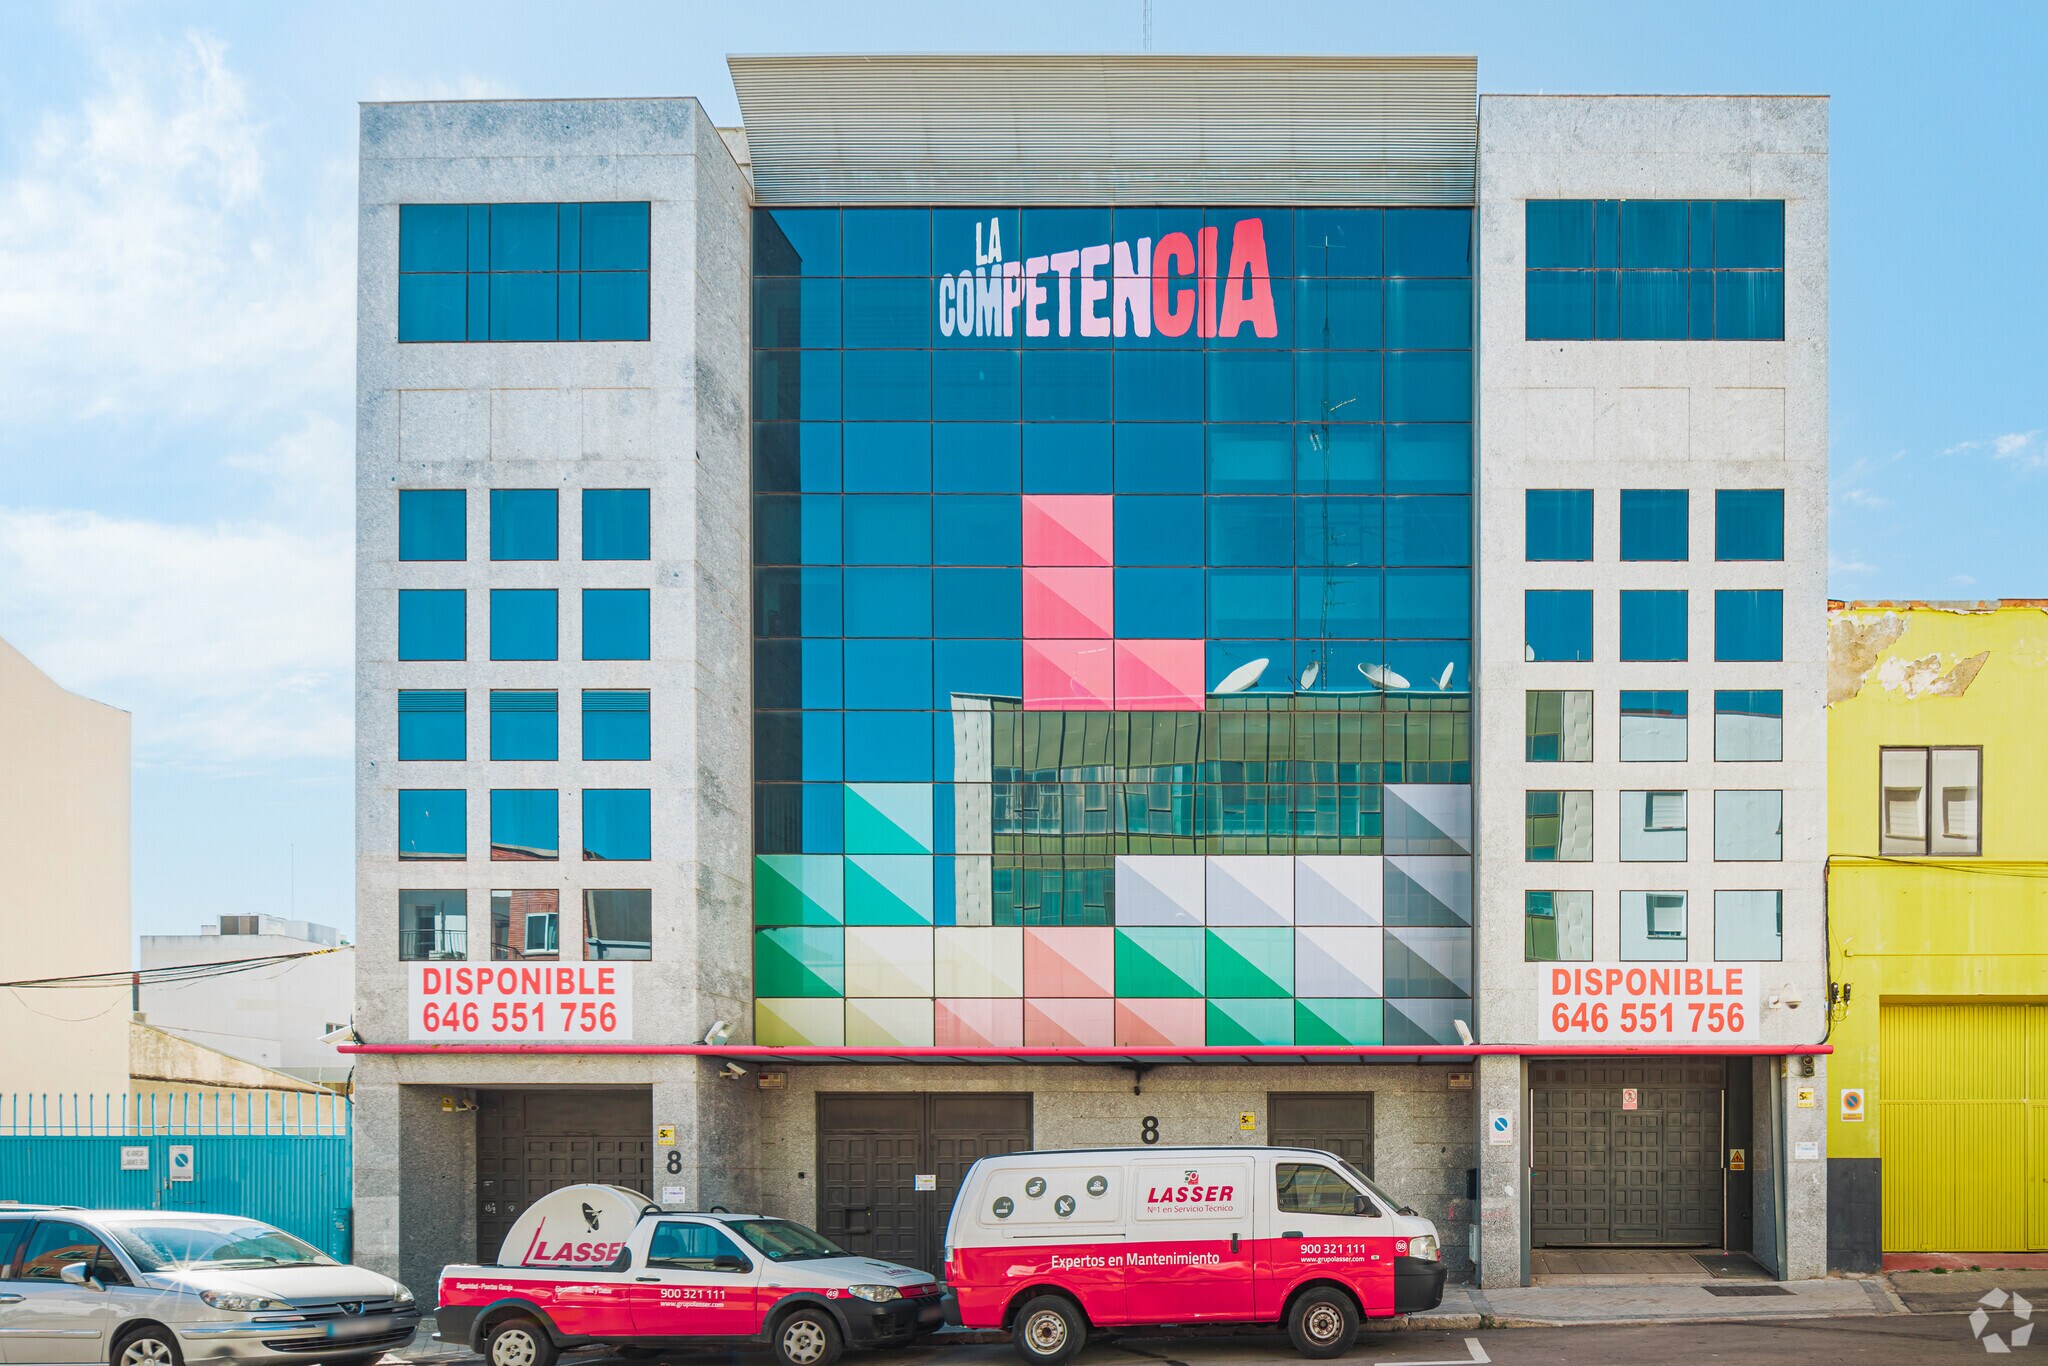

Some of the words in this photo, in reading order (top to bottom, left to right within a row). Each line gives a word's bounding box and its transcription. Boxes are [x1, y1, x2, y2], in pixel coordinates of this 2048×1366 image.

[975, 216, 1003, 267] LA
[938, 217, 1279, 339] COMPETENCIA
[422, 967, 616, 996] DISPONIBLE
[1551, 968, 1744, 996] DISPONIBLE
[422, 1001, 480, 1034] 646
[491, 1001, 545, 1034] 551
[560, 1001, 618, 1034] 756
[1551, 1002, 1609, 1034] 646
[1620, 1002, 1674, 1034] 551
[1687, 1002, 1745, 1034] 756
[1140, 1115, 1160, 1145] 8
[666, 1150, 682, 1175] 8
[1147, 1185, 1234, 1204] LASSER
[1174, 1205, 1203, 1213] Servicio
[1205, 1204, 1234, 1213] Técnico
[533, 1241, 627, 1263] LASSE
[1300, 1243, 1321, 1255] 900
[1323, 1243, 1343, 1254] 321
[1346, 1243, 1365, 1254] 111
[1300, 1255, 1365, 1265] www.grupolasser.com
[1051, 1255, 1105, 1271] Expertos
[1108, 1255, 1123, 1267] en
[1126, 1251, 1221, 1267] Mantenimiento
[660, 1288, 681, 1299] 900
[683, 1288, 703, 1299] 321
[706, 1289, 725, 1300] 111
[660, 1301, 725, 1309] www.grupolasser.com
